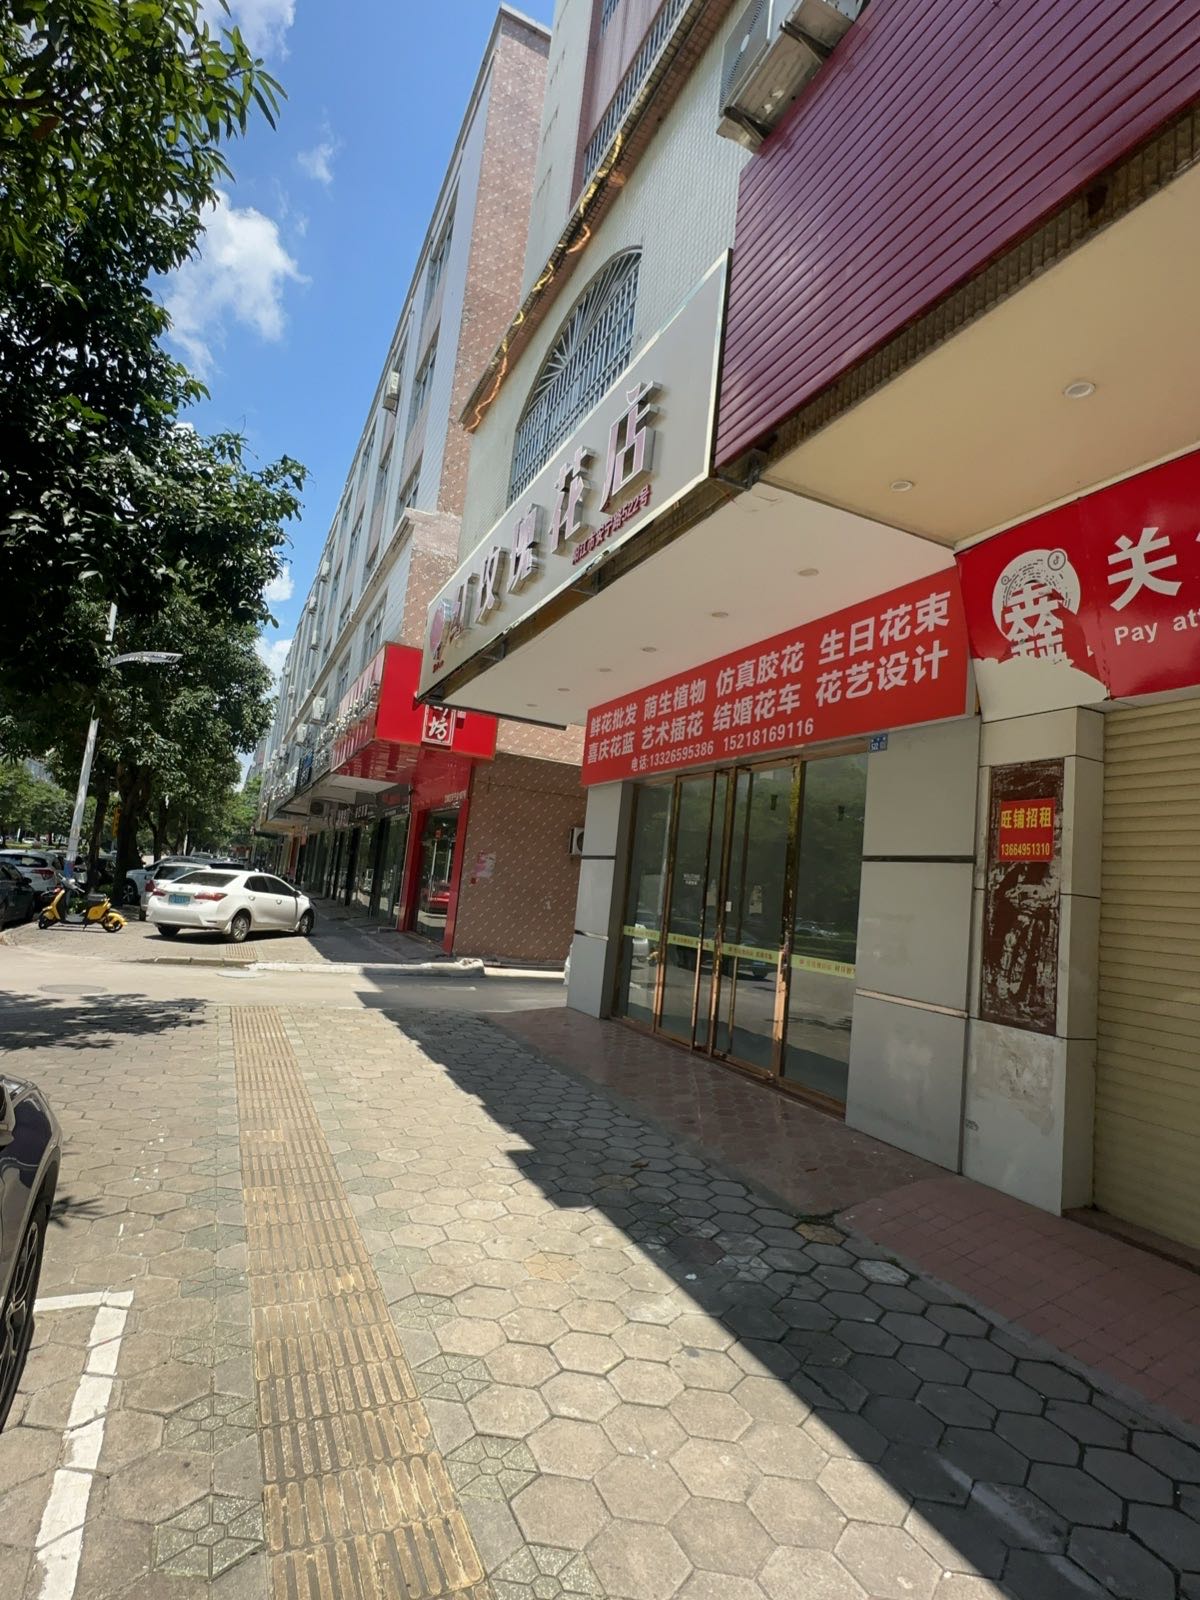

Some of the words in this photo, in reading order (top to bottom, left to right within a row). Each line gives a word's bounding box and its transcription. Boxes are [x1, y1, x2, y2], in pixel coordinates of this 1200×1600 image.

[1107, 527, 1200, 611] 关
[1114, 622, 1158, 646] Pay
[1173, 608, 1200, 632] at
[589, 703, 638, 738] 鲜花批发
[716, 641, 805, 698] 仿真胶花
[818, 591, 951, 665] 生日花束
[641, 710, 704, 750] 艺术插花
[712, 683, 801, 732] 结婚花车
[815, 640, 949, 707] 花艺设计
[723, 718, 814, 752] 15218169116
[1001, 807, 1052, 829] 旺铺招租
[1001, 842, 1050, 856] 13664951310
